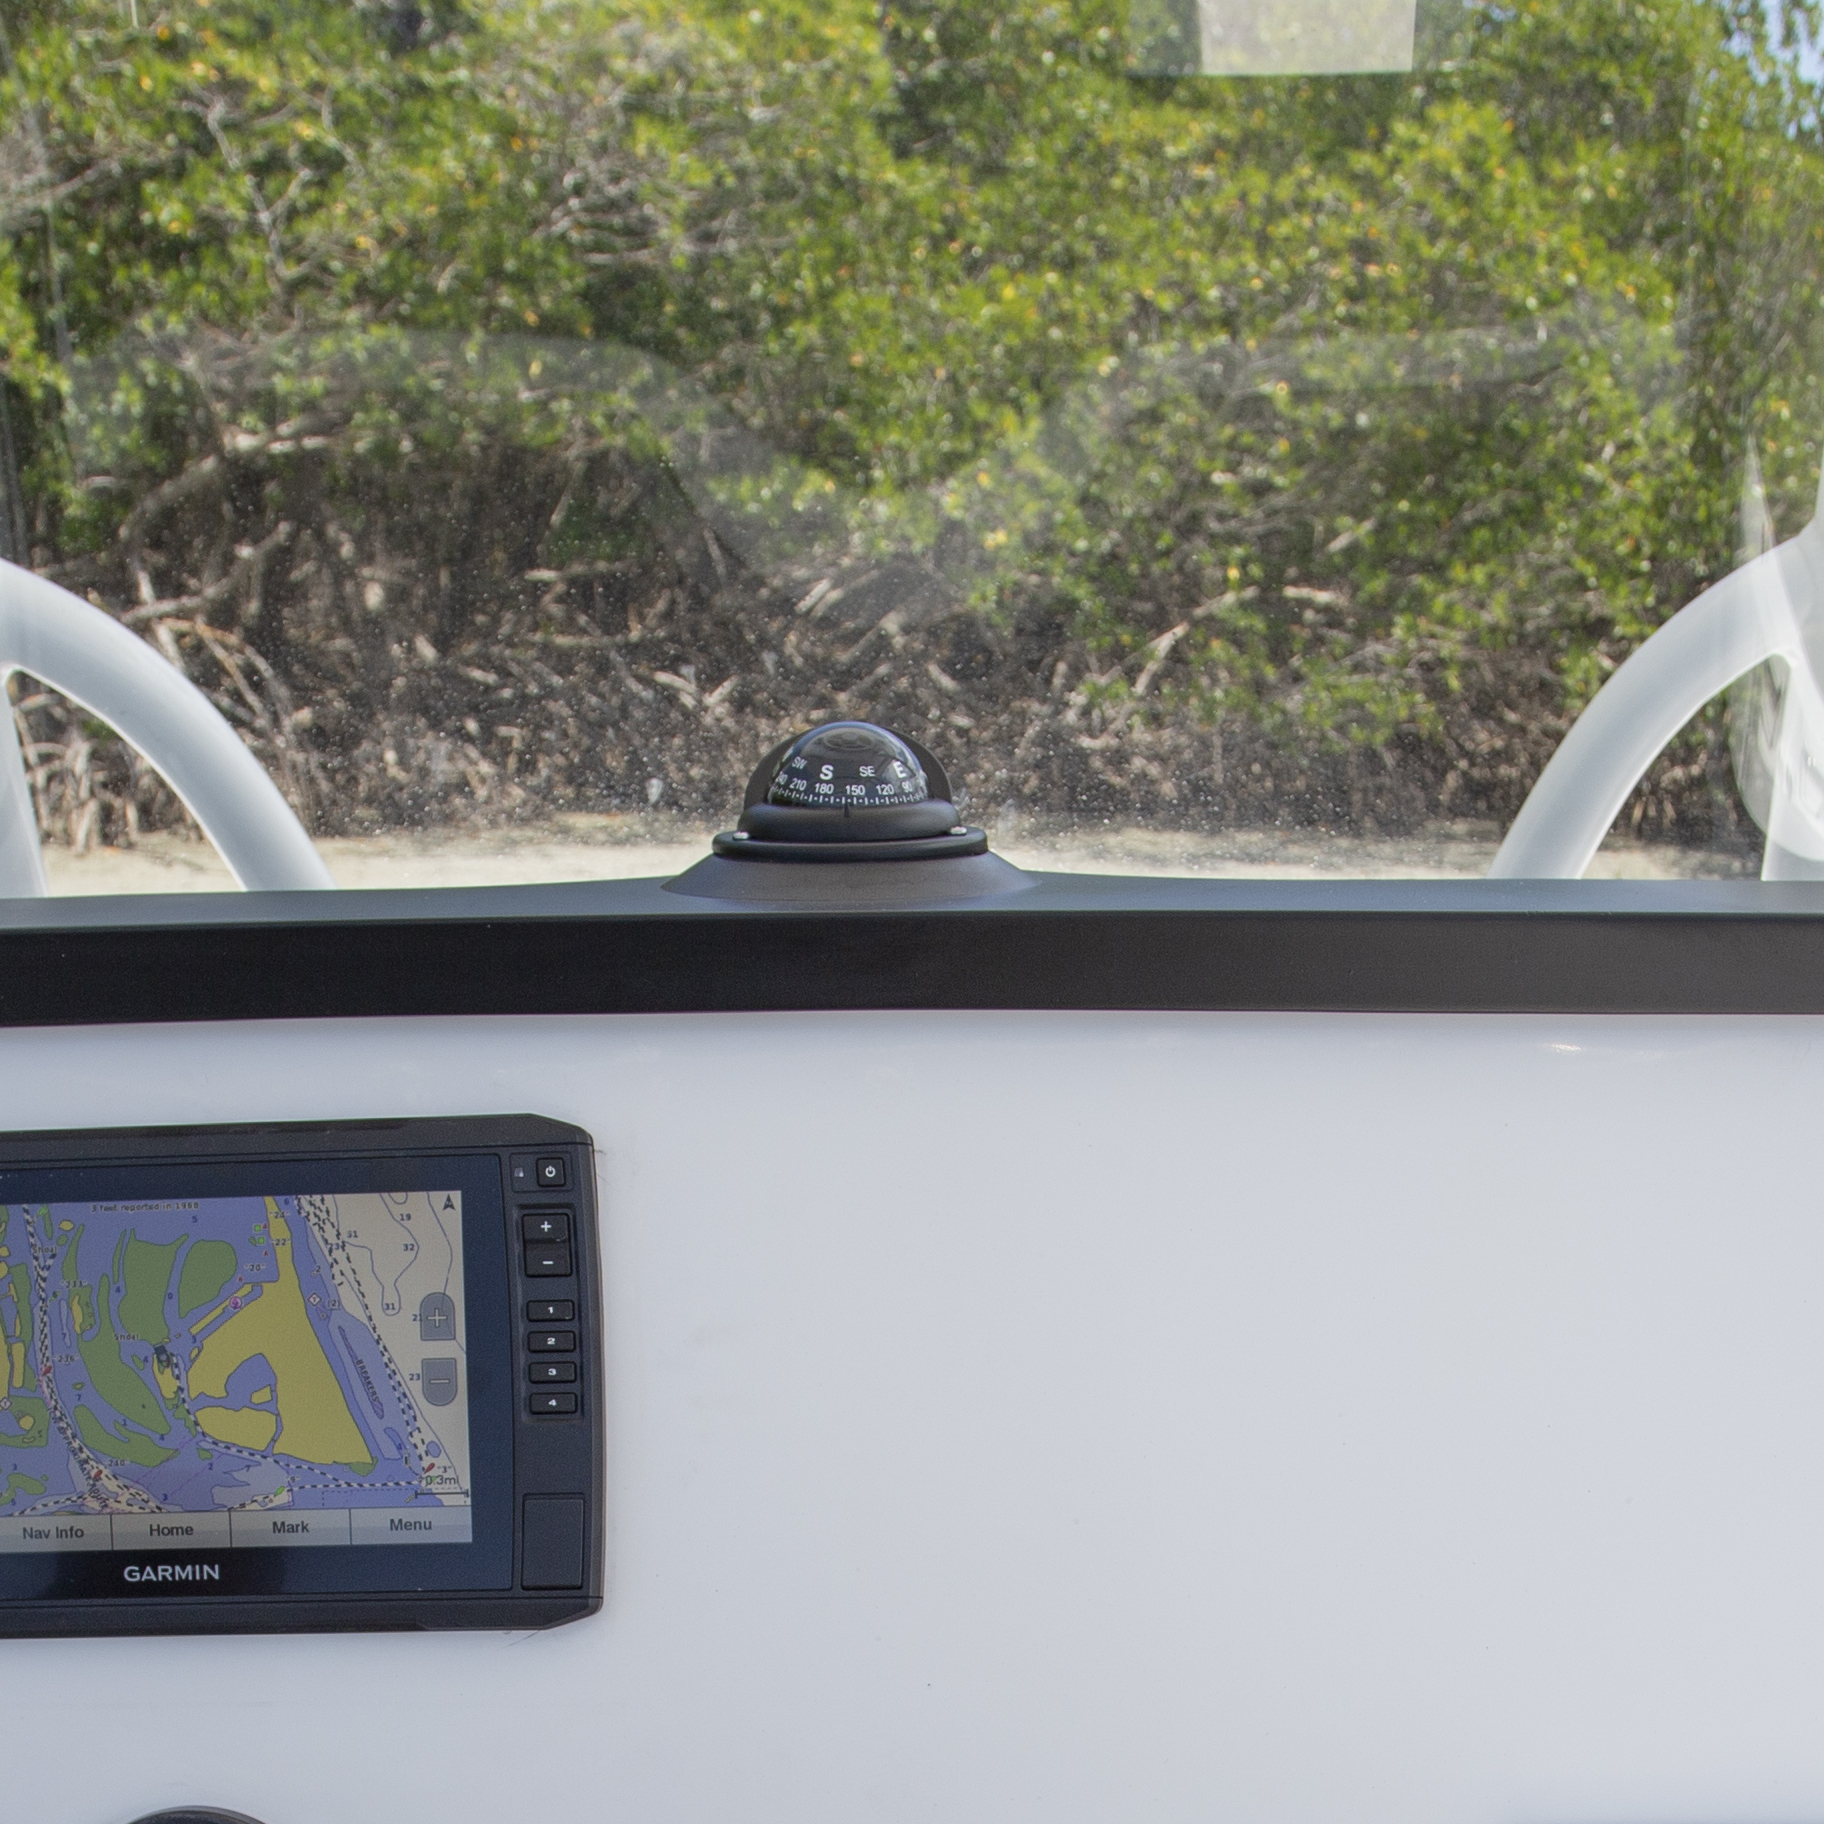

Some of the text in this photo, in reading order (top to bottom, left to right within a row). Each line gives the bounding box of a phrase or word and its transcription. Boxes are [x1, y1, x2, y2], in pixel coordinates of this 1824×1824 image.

[792, 756, 907, 780] SW S SE E
[789, 778, 912, 796] 210 180 150 120 90
[547, 1305, 554, 1314] 1
[546, 1336, 556, 1345] 2
[547, 1367, 557, 1376] 3
[547, 1398, 557, 1406] 4
[148, 1523, 194, 1537] Home
[271, 1520, 310, 1534] Mark
[389, 1517, 433, 1531] Menu
[21, 1526, 84, 1540] Nav Info
[122, 1564, 220, 1581] GARMIN
